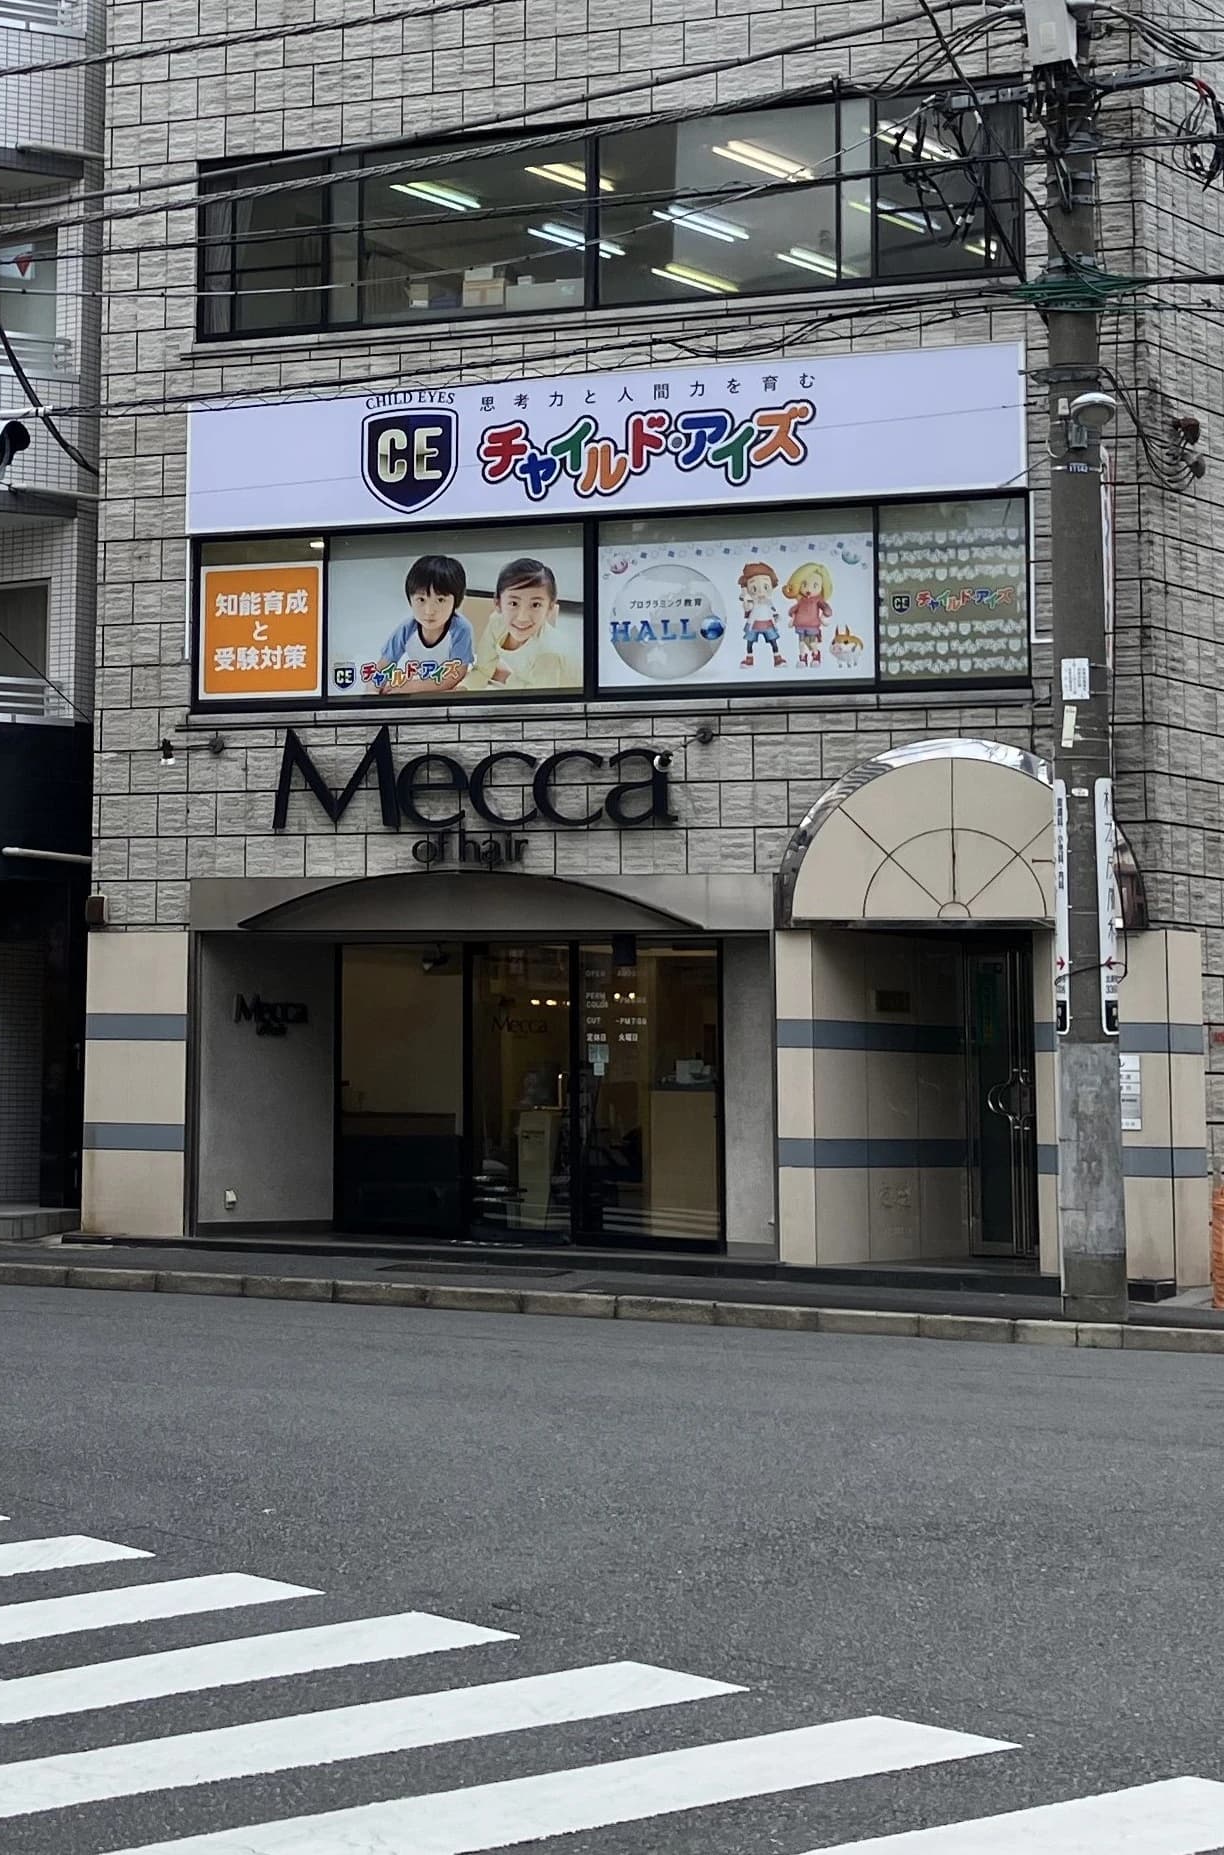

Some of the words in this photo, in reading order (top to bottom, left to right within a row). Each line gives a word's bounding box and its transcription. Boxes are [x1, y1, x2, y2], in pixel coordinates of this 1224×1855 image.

[366, 392, 413, 410] CHILD
[418, 391, 455, 405] EYES
[480, 372, 815, 412] 思考力と人間力を育む
[377, 426, 444, 483] CE
[215, 589, 309, 618] 知能育成
[629, 597, 702, 610] プログラミング教育
[252, 621, 269, 642] と
[214, 644, 307, 672] 受験対策
[273, 725, 678, 829] Mecca
[412, 829, 449, 864] of
[459, 829, 529, 864] hair
